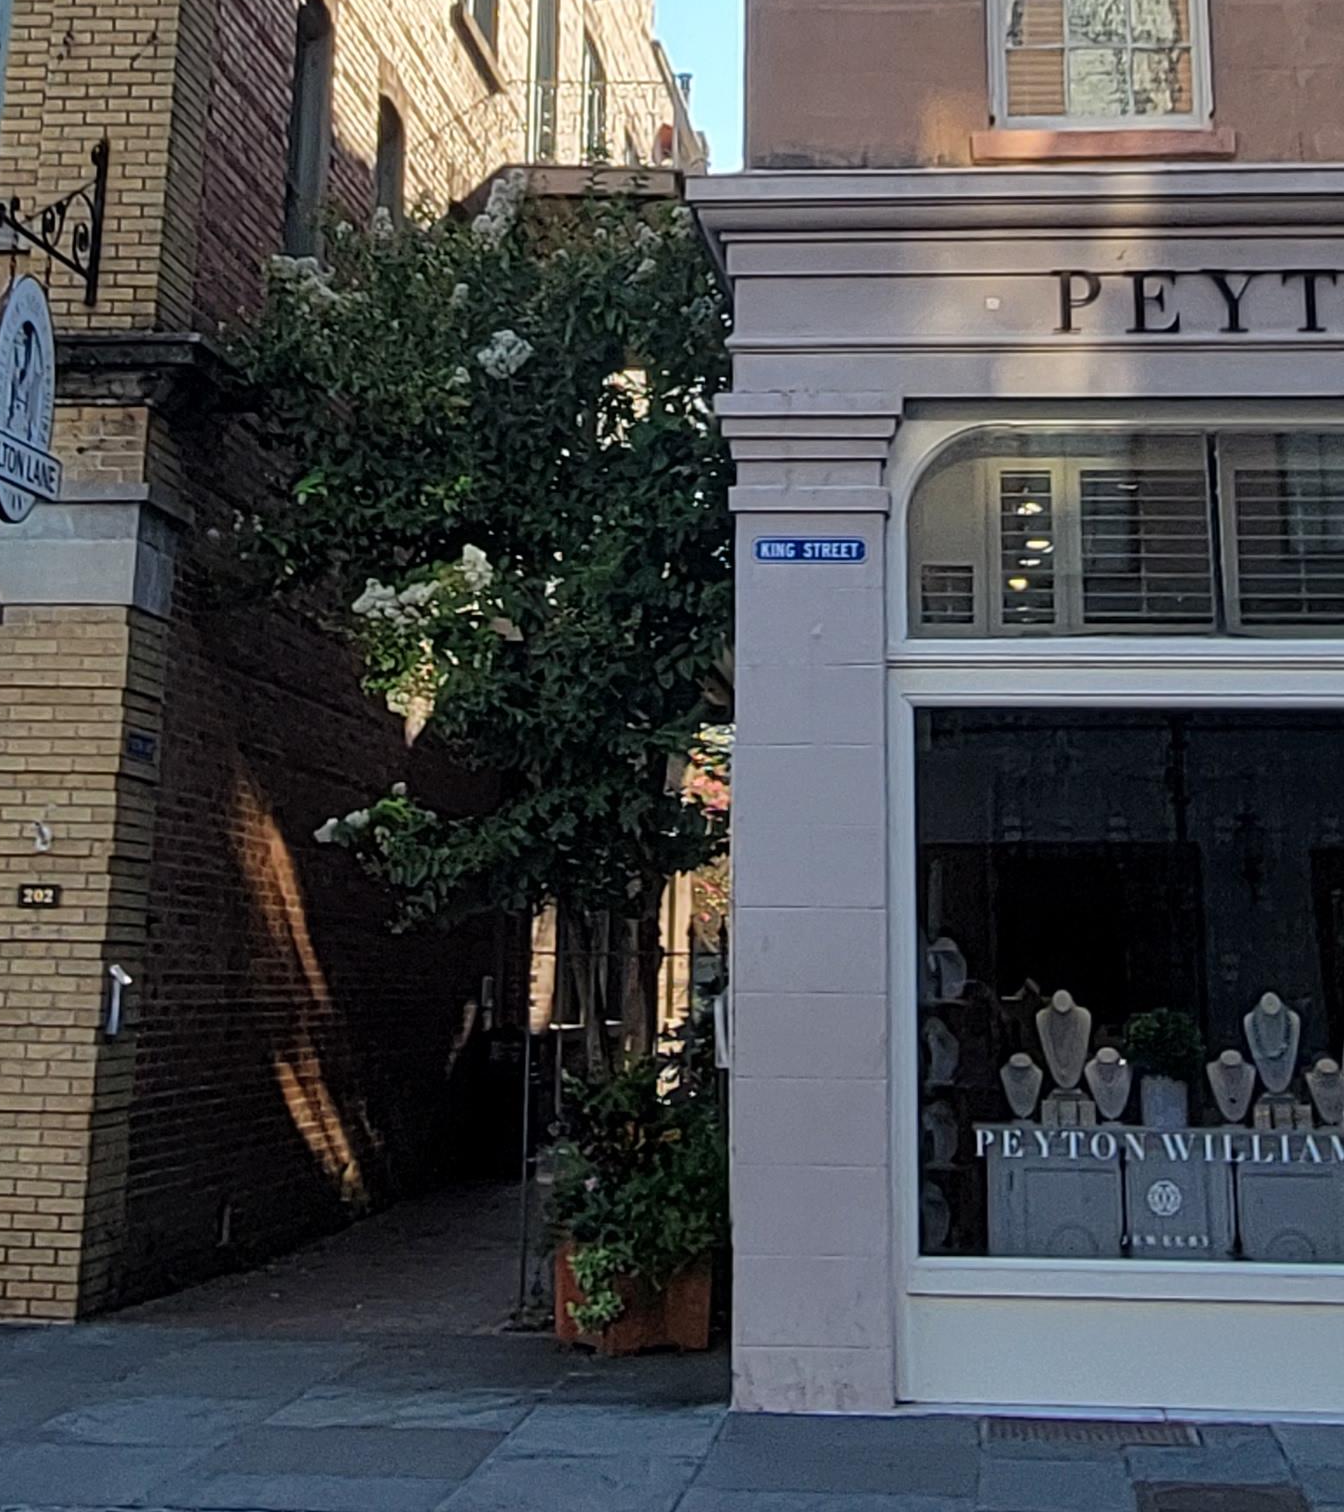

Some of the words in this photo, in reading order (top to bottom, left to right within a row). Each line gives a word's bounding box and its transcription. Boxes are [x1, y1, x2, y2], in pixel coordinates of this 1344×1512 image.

[25, 454, 58, 495] LANE
[759, 542, 797, 559] KING
[802, 542, 860, 559] STREET
[22, 887, 54, 904] 202
[975, 1127, 1147, 1162] PEYTON
